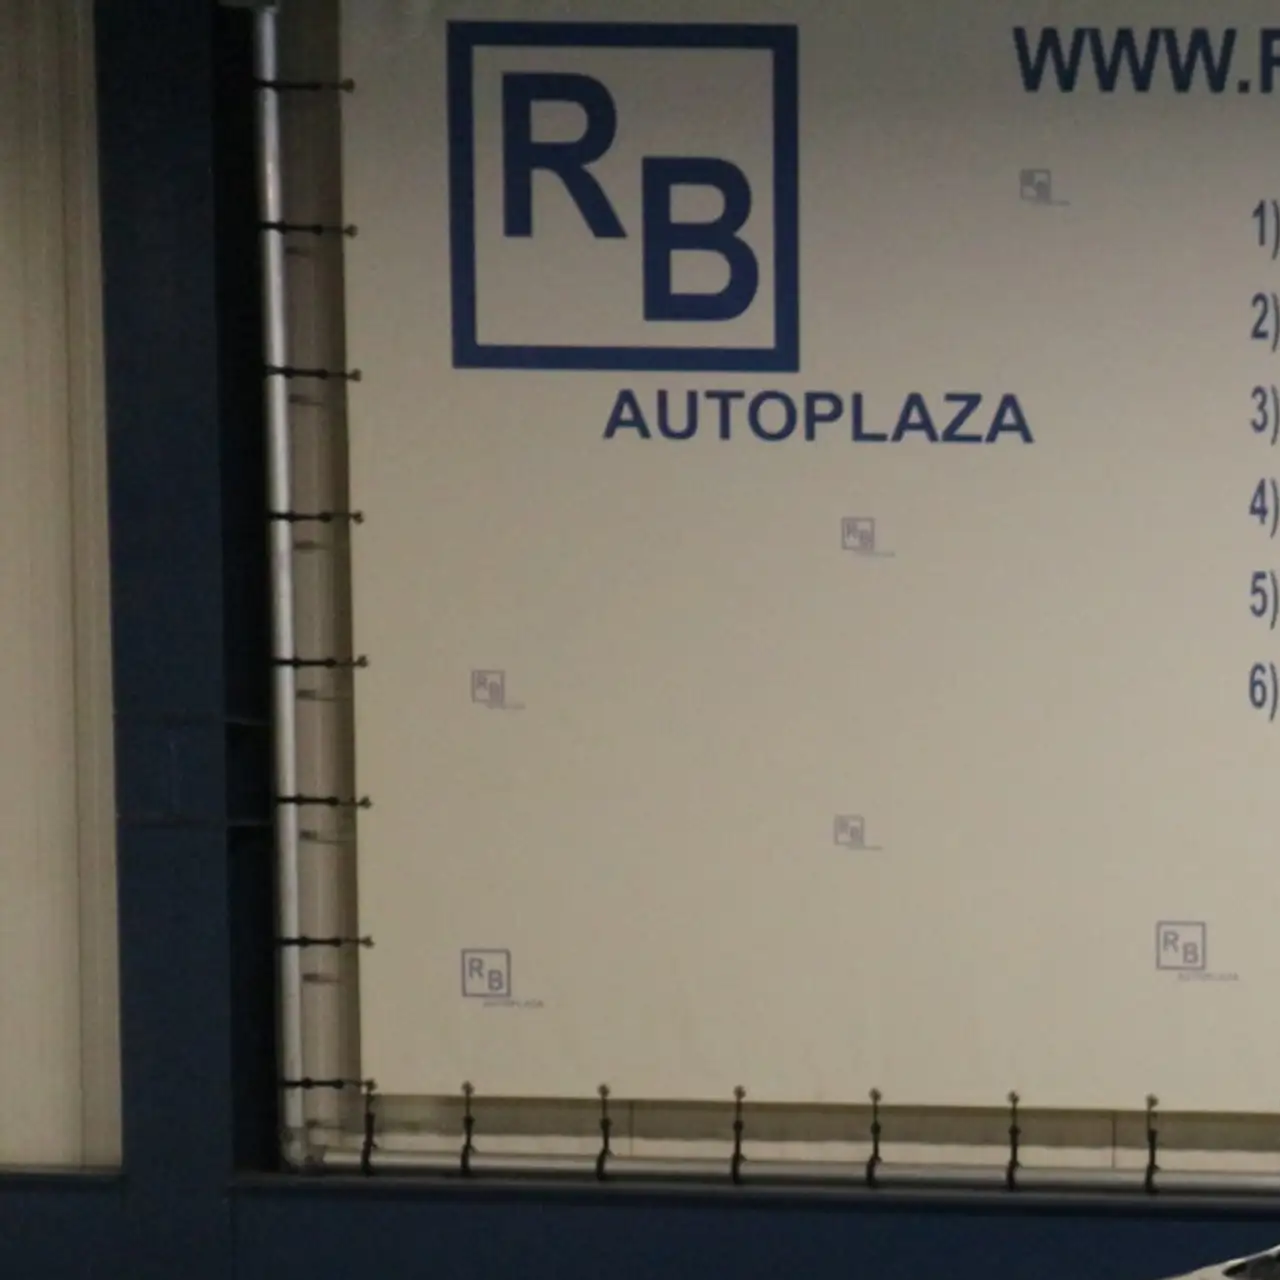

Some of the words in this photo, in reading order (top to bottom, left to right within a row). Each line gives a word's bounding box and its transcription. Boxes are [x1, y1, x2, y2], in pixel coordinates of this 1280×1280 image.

[502, 72, 760, 322] RB
[602, 389, 1034, 444] AUTOPLAZA
[1250, 386, 1280, 445] 3)
[1248, 479, 1280, 538] 4)
[1249, 571, 1280, 629] 5)
[1248, 663, 1279, 720] 6)
